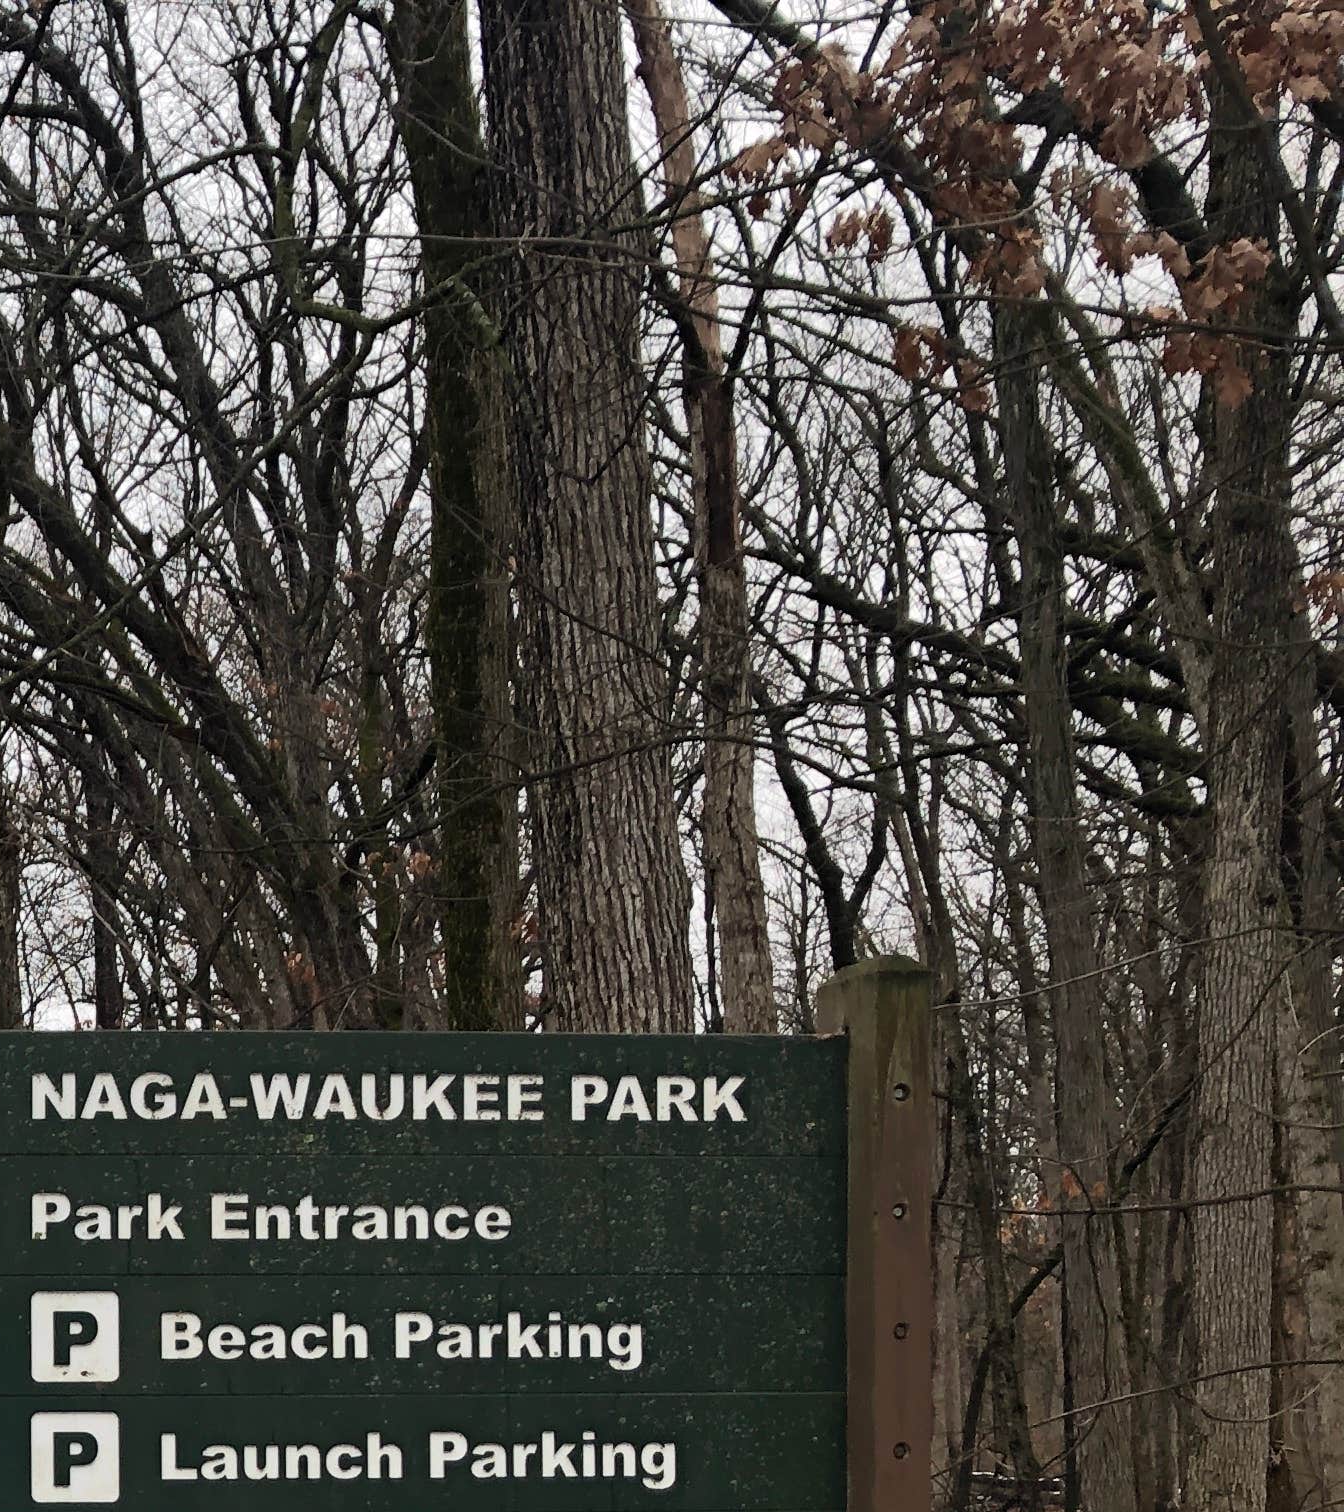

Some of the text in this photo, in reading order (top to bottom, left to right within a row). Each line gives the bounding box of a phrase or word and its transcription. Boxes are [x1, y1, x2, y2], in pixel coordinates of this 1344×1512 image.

[30, 1072, 748, 1123] NAGA-WAUKEE PARK
[30, 1193, 513, 1242] Park Entrance
[52, 1310, 99, 1368] P
[160, 1310, 644, 1372] Beach Parking
[52, 1431, 99, 1489] P
[160, 1430, 677, 1491] Launch Parking
